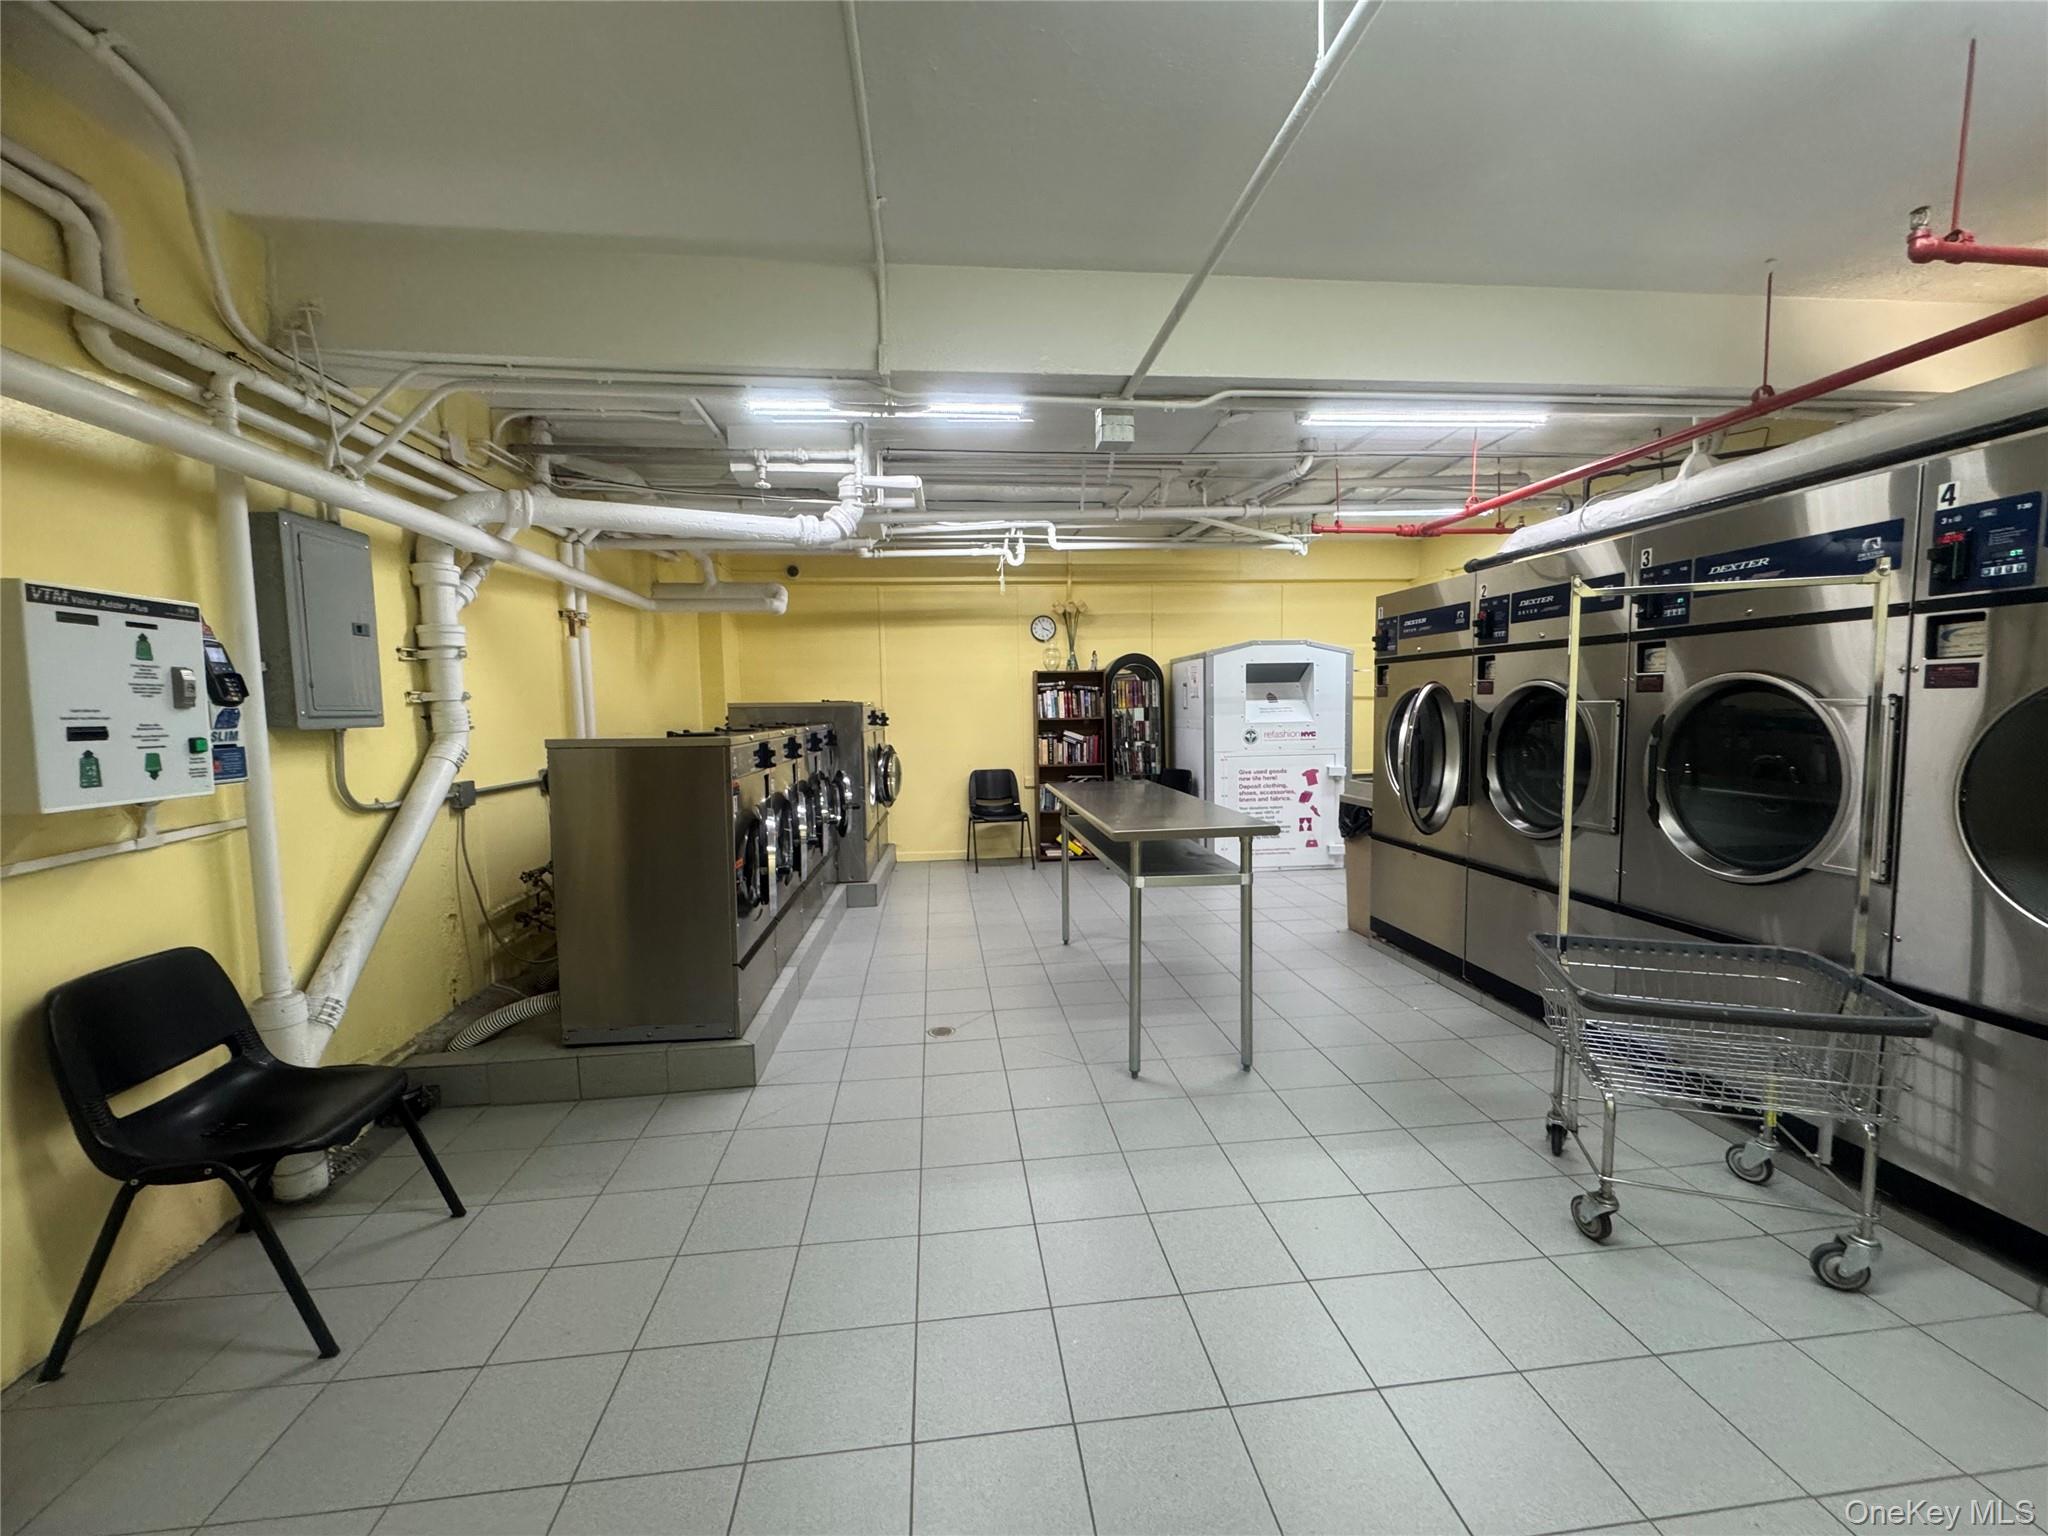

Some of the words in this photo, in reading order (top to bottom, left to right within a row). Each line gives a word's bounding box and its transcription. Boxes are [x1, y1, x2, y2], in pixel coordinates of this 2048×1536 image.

[1940, 483, 1956, 506] 4
[1642, 550, 1650, 567] 3
[1708, 557, 1770, 575] DEXTER
[1481, 585, 1487, 597] 2
[31, 587, 69, 604] VTM
[71, 595, 98, 606] Value
[100, 600, 127, 610] Adder
[129, 603, 149, 613] Plus
[1519, 595, 1554, 607] DEXTER
[211, 731, 239, 742] SLIM
